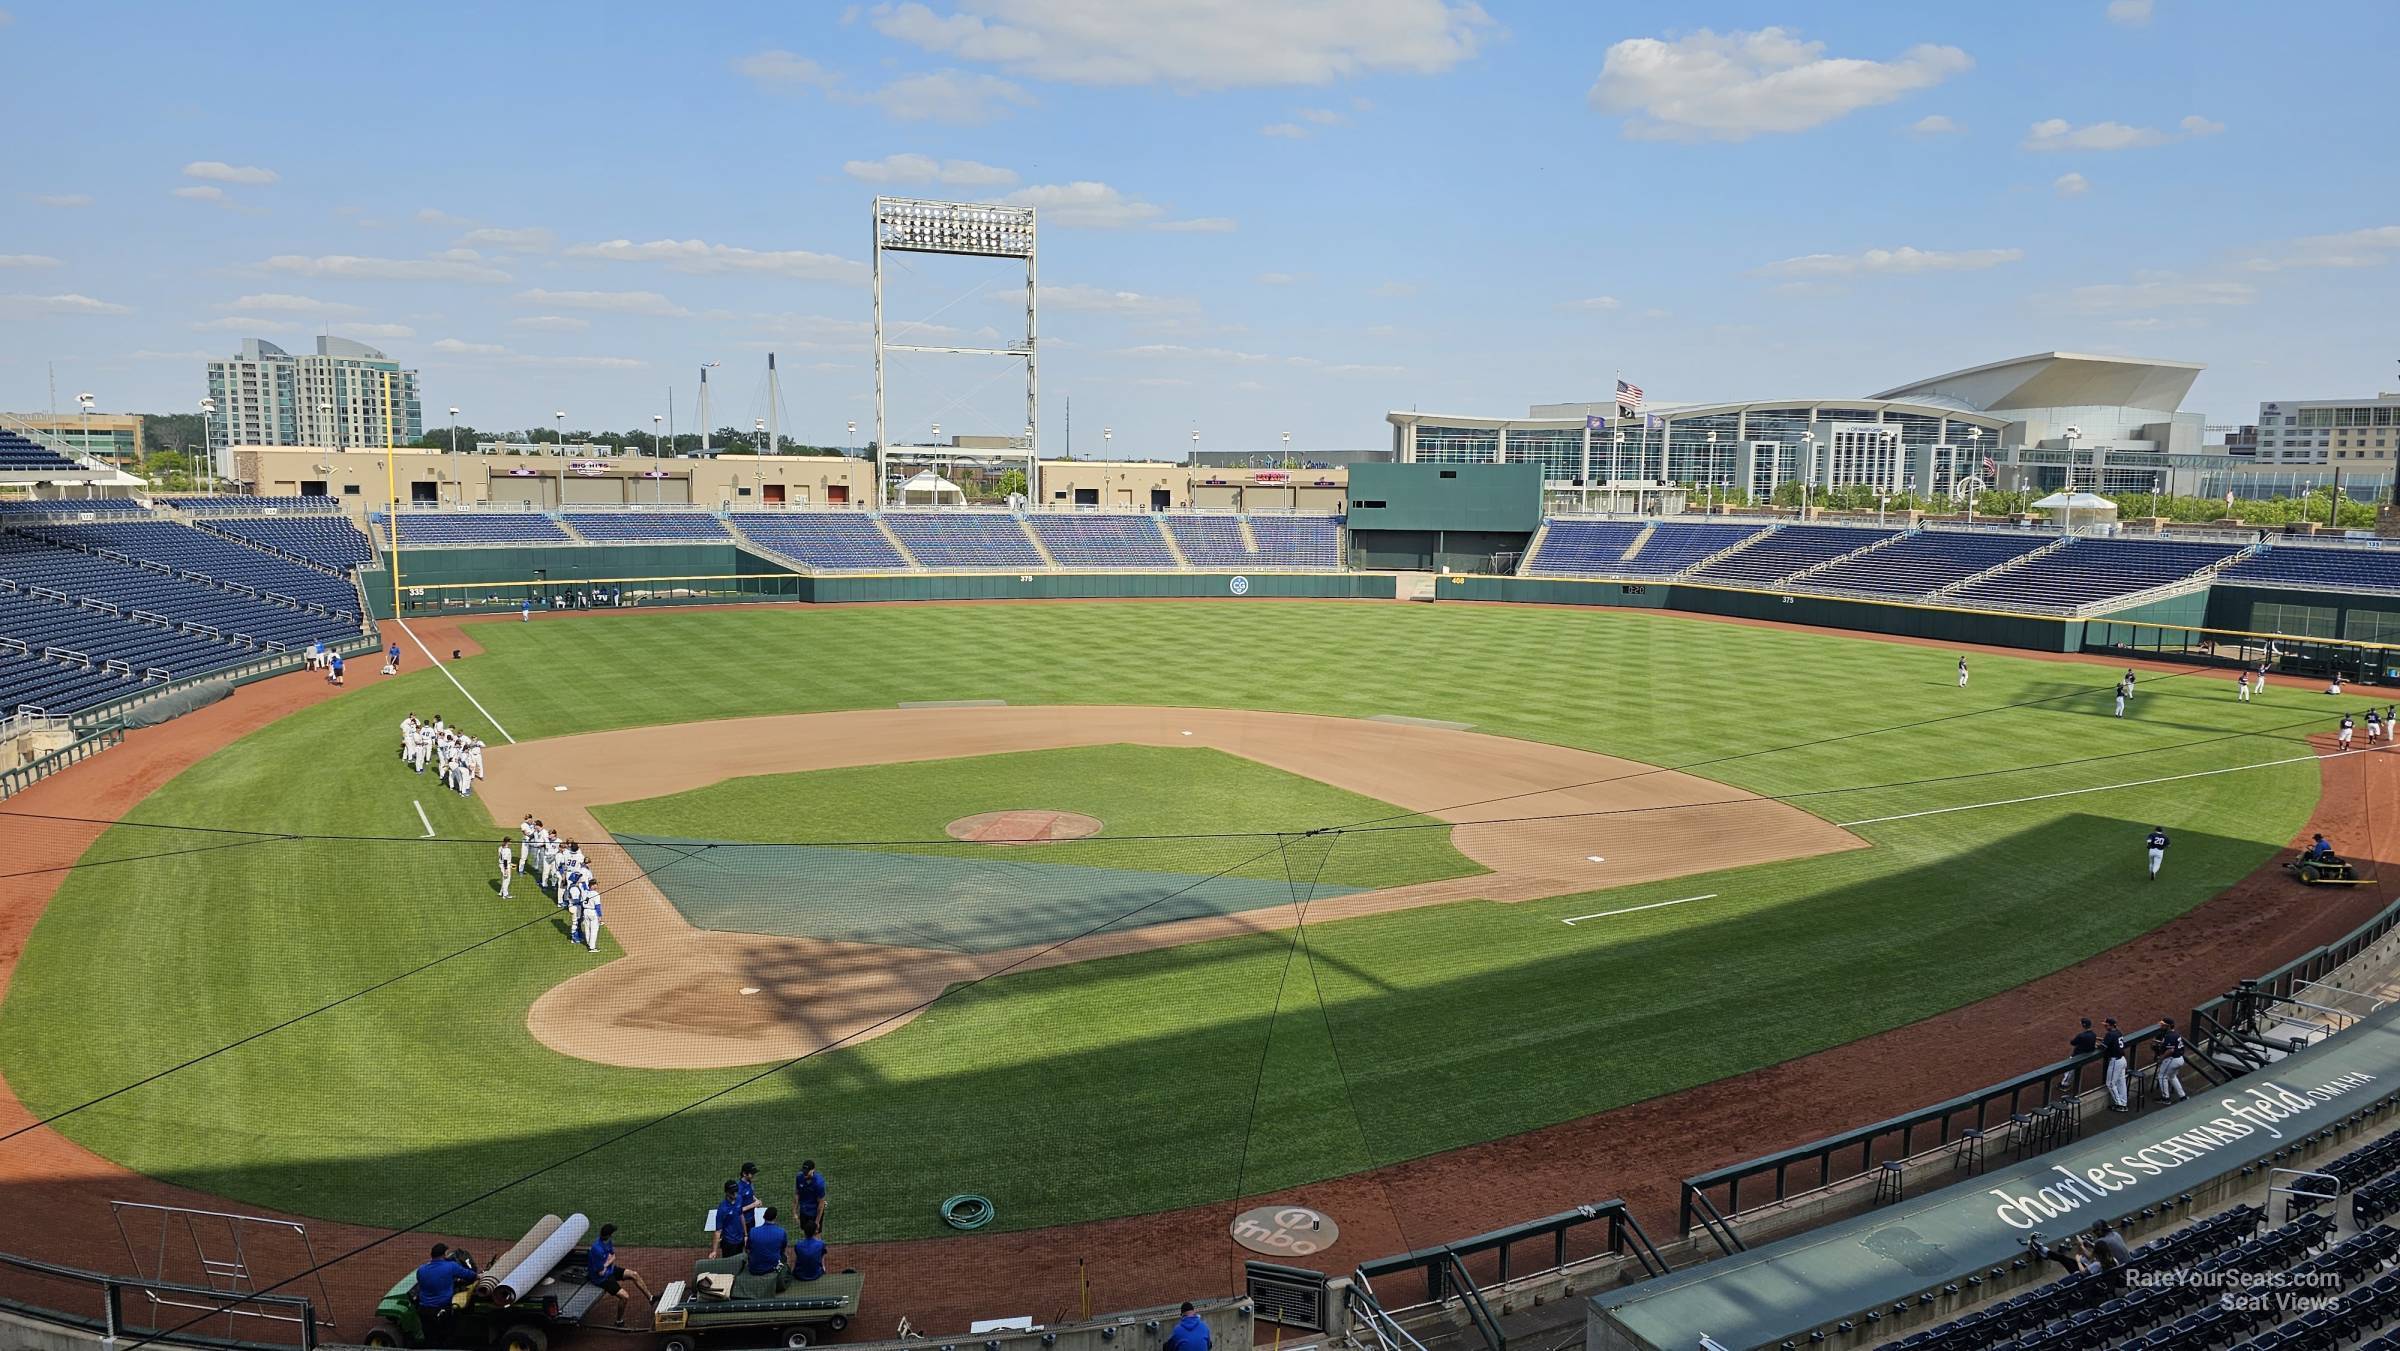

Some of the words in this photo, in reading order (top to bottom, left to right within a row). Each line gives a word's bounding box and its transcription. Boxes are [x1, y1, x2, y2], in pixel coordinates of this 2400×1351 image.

[409, 588, 425, 596] 335
[2154, 836, 2165, 846] 20
[1988, 1164, 2138, 1230] charles
[2121, 1117, 2256, 1176] SCHWAB
[2222, 1081, 2318, 1139] field
[2306, 1070, 2377, 1102] OMAHA
[1233, 1218, 1318, 1255] fnbo
